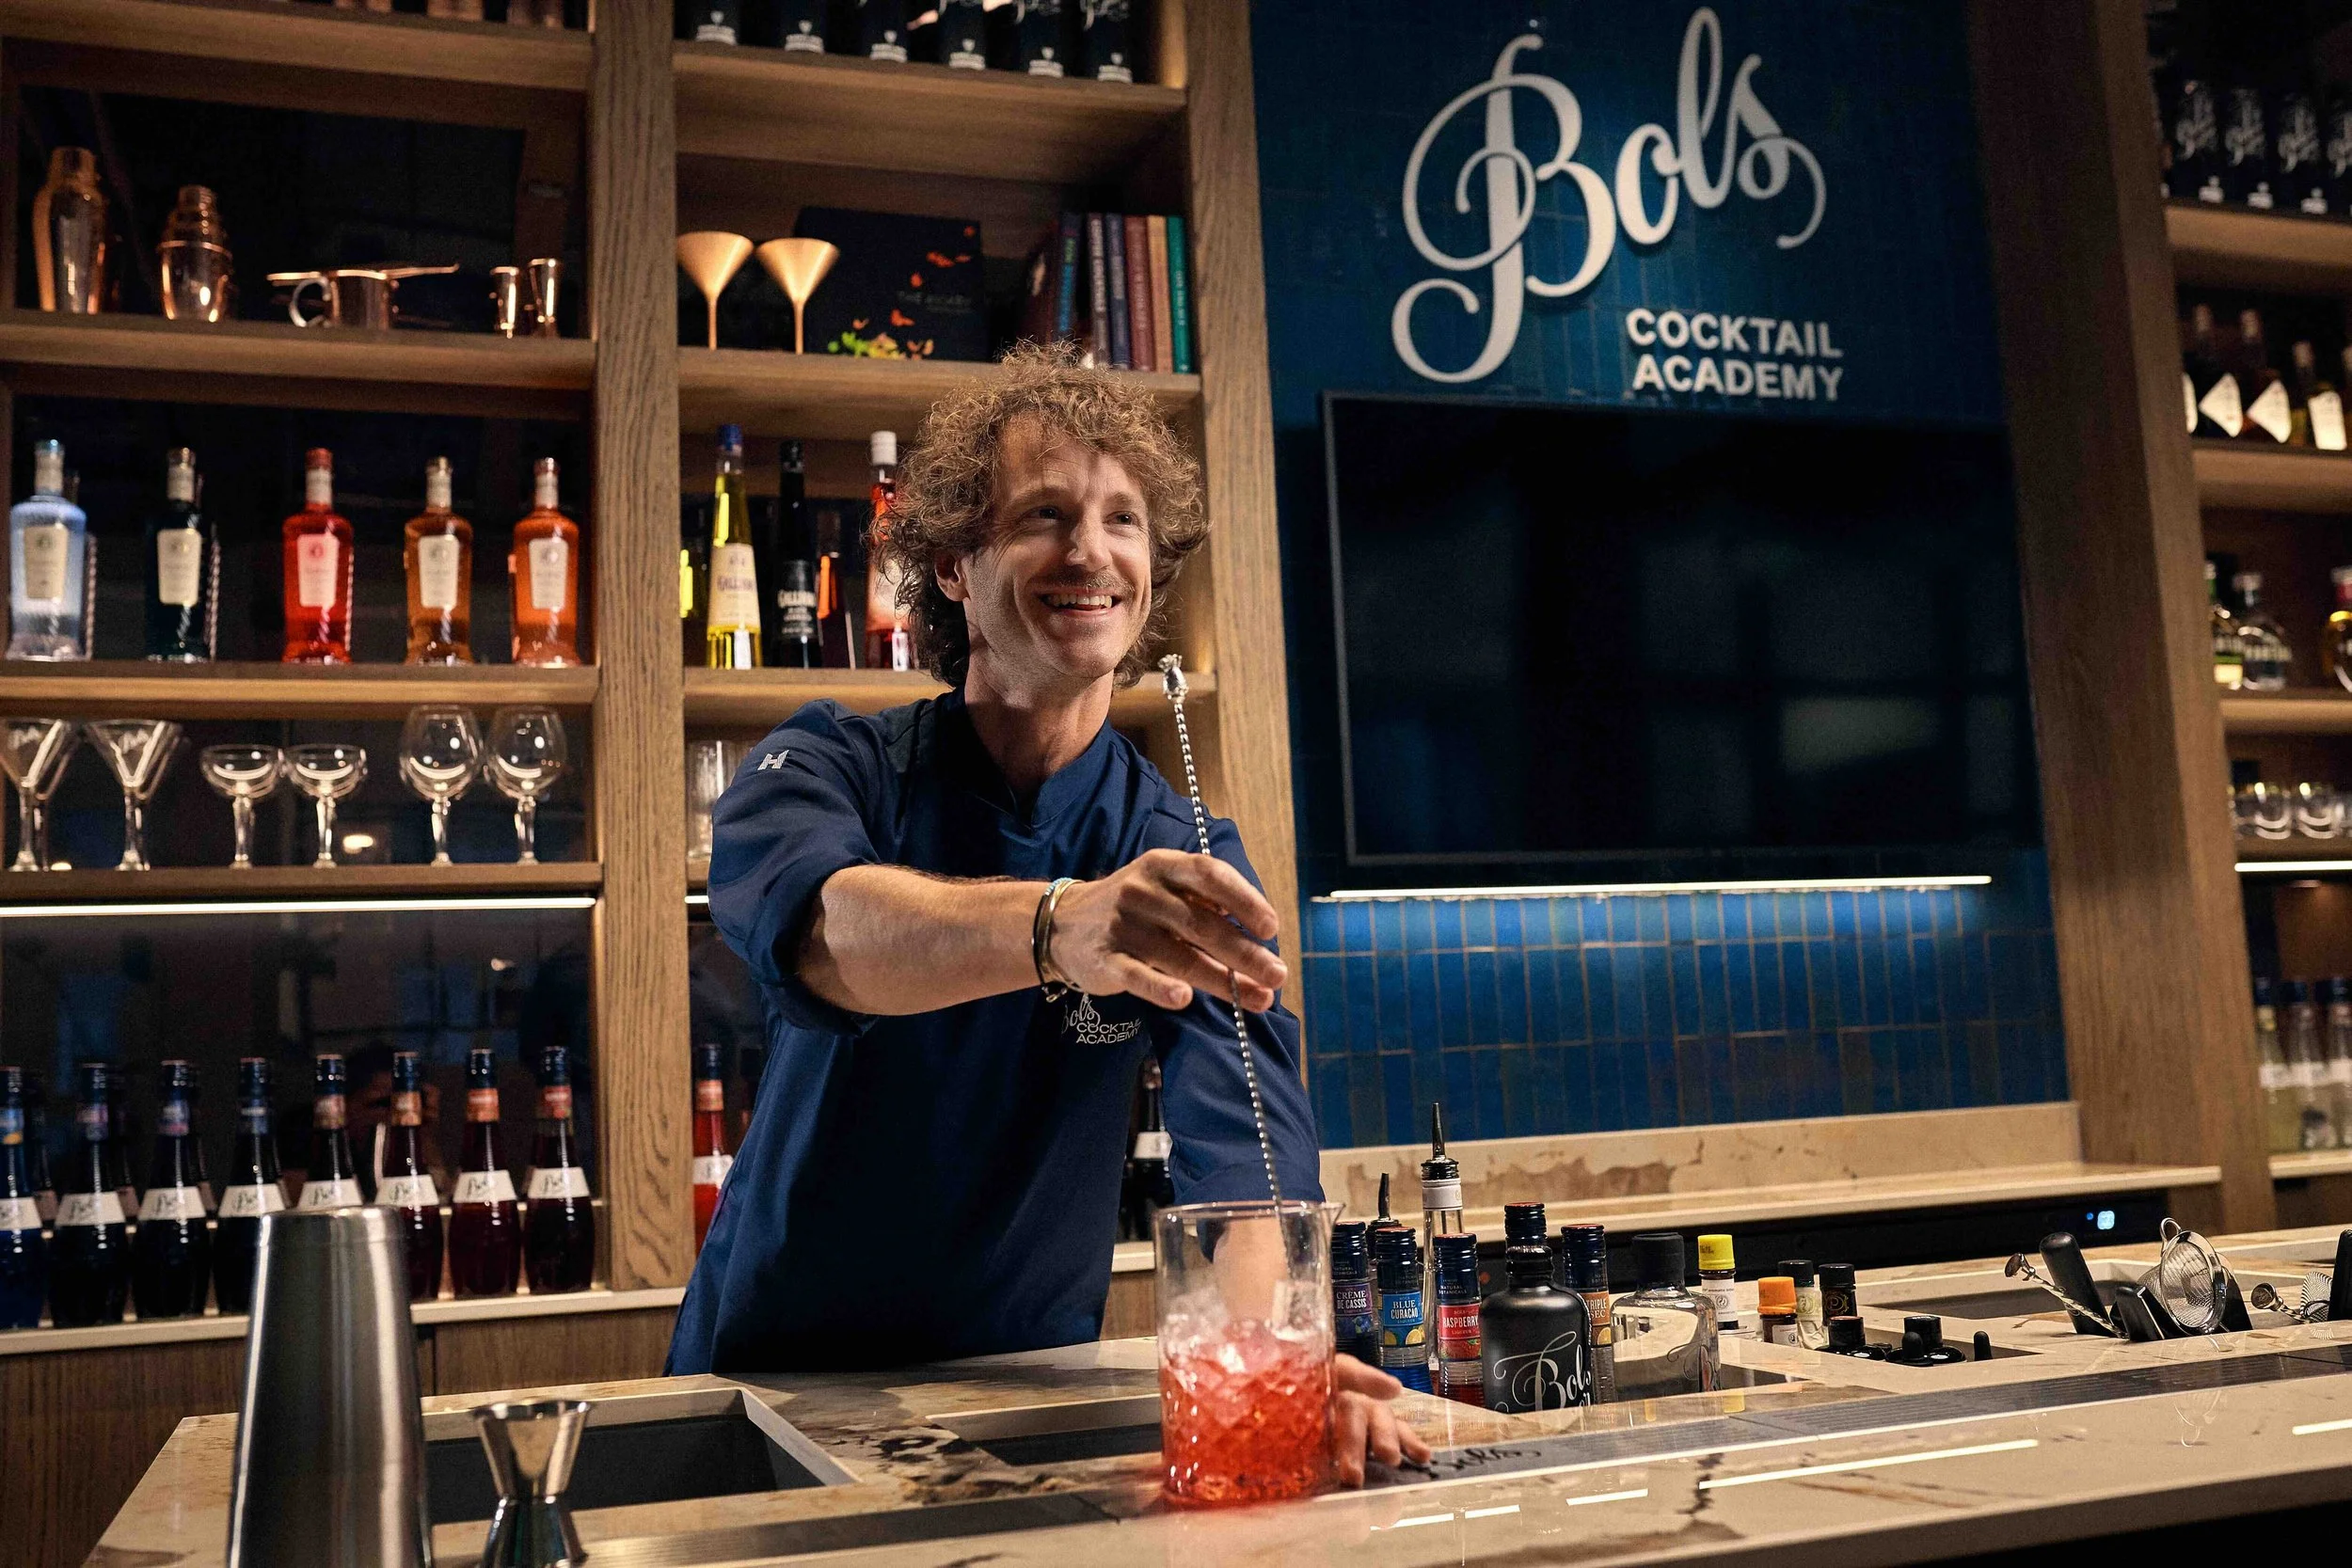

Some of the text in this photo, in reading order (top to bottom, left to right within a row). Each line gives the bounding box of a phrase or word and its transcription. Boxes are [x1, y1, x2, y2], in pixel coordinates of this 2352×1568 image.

[1391, 6, 1827, 383] Bols
[1625, 307, 1845, 359] COCKTAIL
[1631, 353, 1845, 402] ACADEMY
[1075, 1027, 1139, 1044] ACADEMY
[1337, 1298, 1367, 1309] DE CASSIS
[1393, 1300, 1416, 1308] BLUE
[1586, 1299, 1607, 1309] TRIPLE
[1590, 1309, 1606, 1319] SEC
[1442, 1315, 1479, 1328] RASPBERRY
